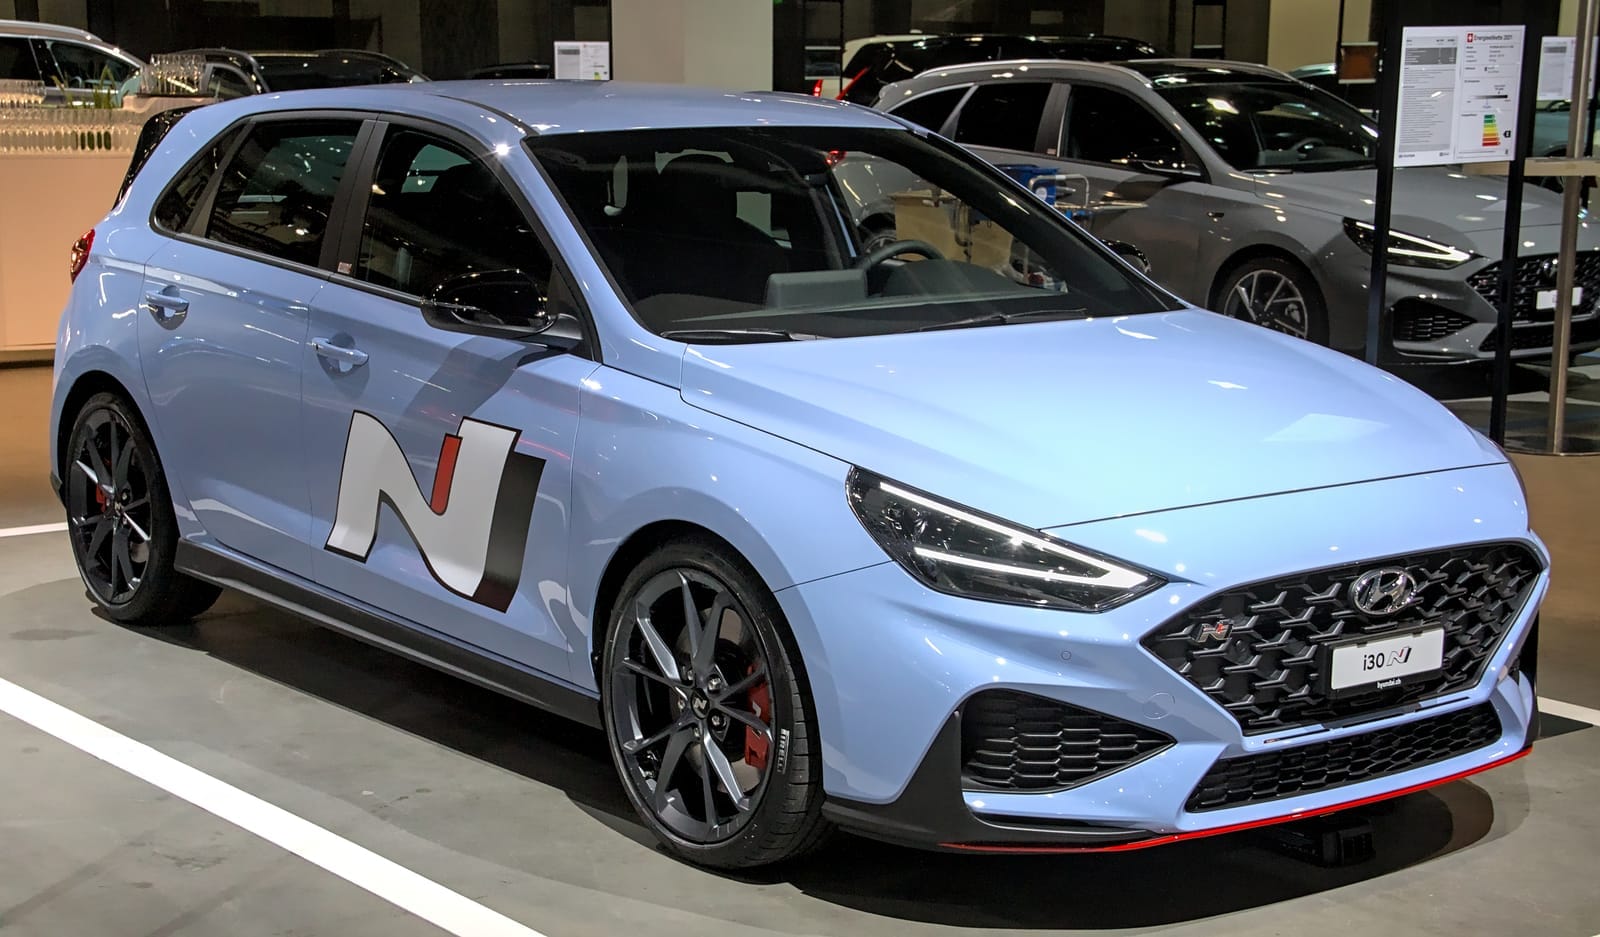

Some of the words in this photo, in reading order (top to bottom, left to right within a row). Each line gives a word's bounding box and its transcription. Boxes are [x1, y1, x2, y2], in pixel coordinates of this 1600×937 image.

[323, 409, 547, 613] N
[1363, 652, 1385, 671] i30
[1386, 646, 1412, 667] N
[777, 728, 790, 775] PIRELLI
